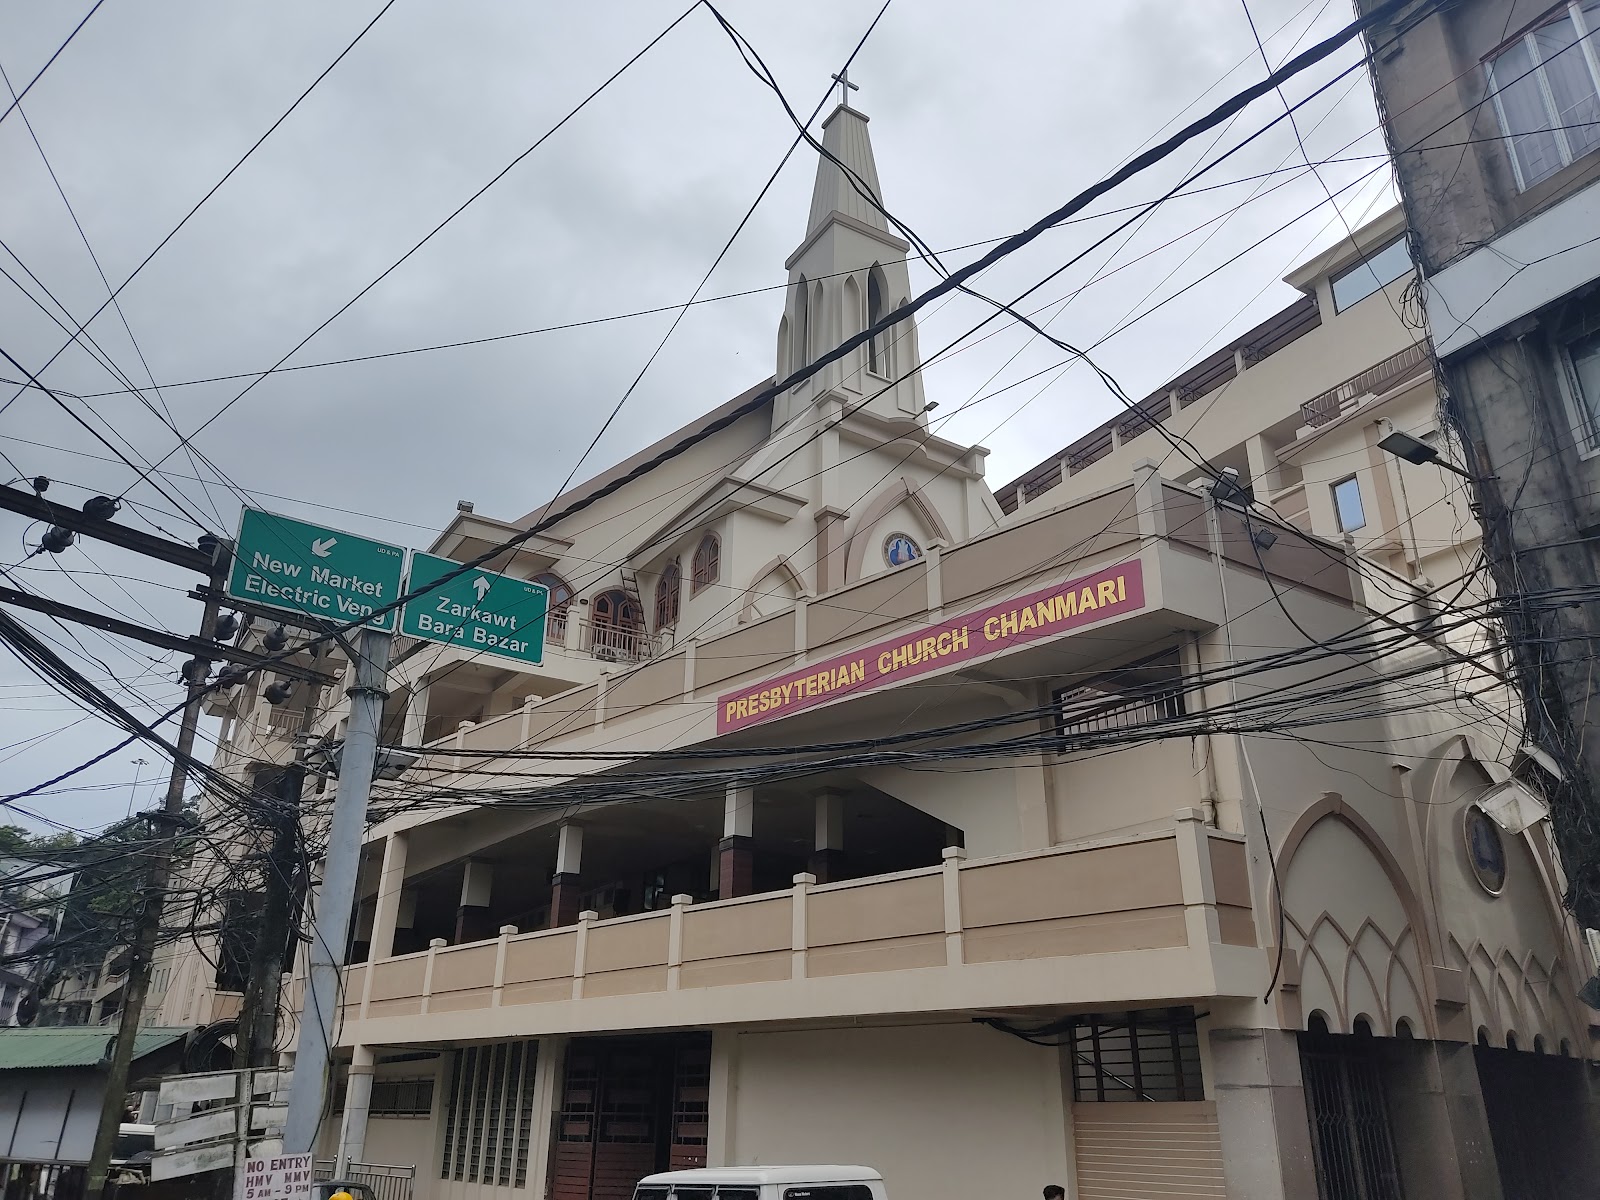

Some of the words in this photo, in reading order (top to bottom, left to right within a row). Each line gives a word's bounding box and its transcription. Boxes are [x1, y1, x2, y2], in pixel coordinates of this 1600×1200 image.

[244, 573, 331, 609] Electric
[252, 551, 302, 578] New
[310, 565, 383, 598] Market
[436, 595, 517, 631] Zarkawt
[417, 613, 465, 639] Bara
[473, 626, 529, 653] Bazar
[726, 658, 865, 723] PRESBYTERIAN
[877, 625, 969, 675] CHURCH
[983, 575, 1127, 642] CHANMARI
[245, 1174, 273, 1188] HMV
[283, 1170, 311, 1184] MMV
[246, 1160, 265, 1174] NO
[270, 1155, 311, 1172] ENTRY
[246, 1188, 254, 1199] 5
[284, 1184, 292, 1195] 9
[295, 1184, 309, 1194] PM
